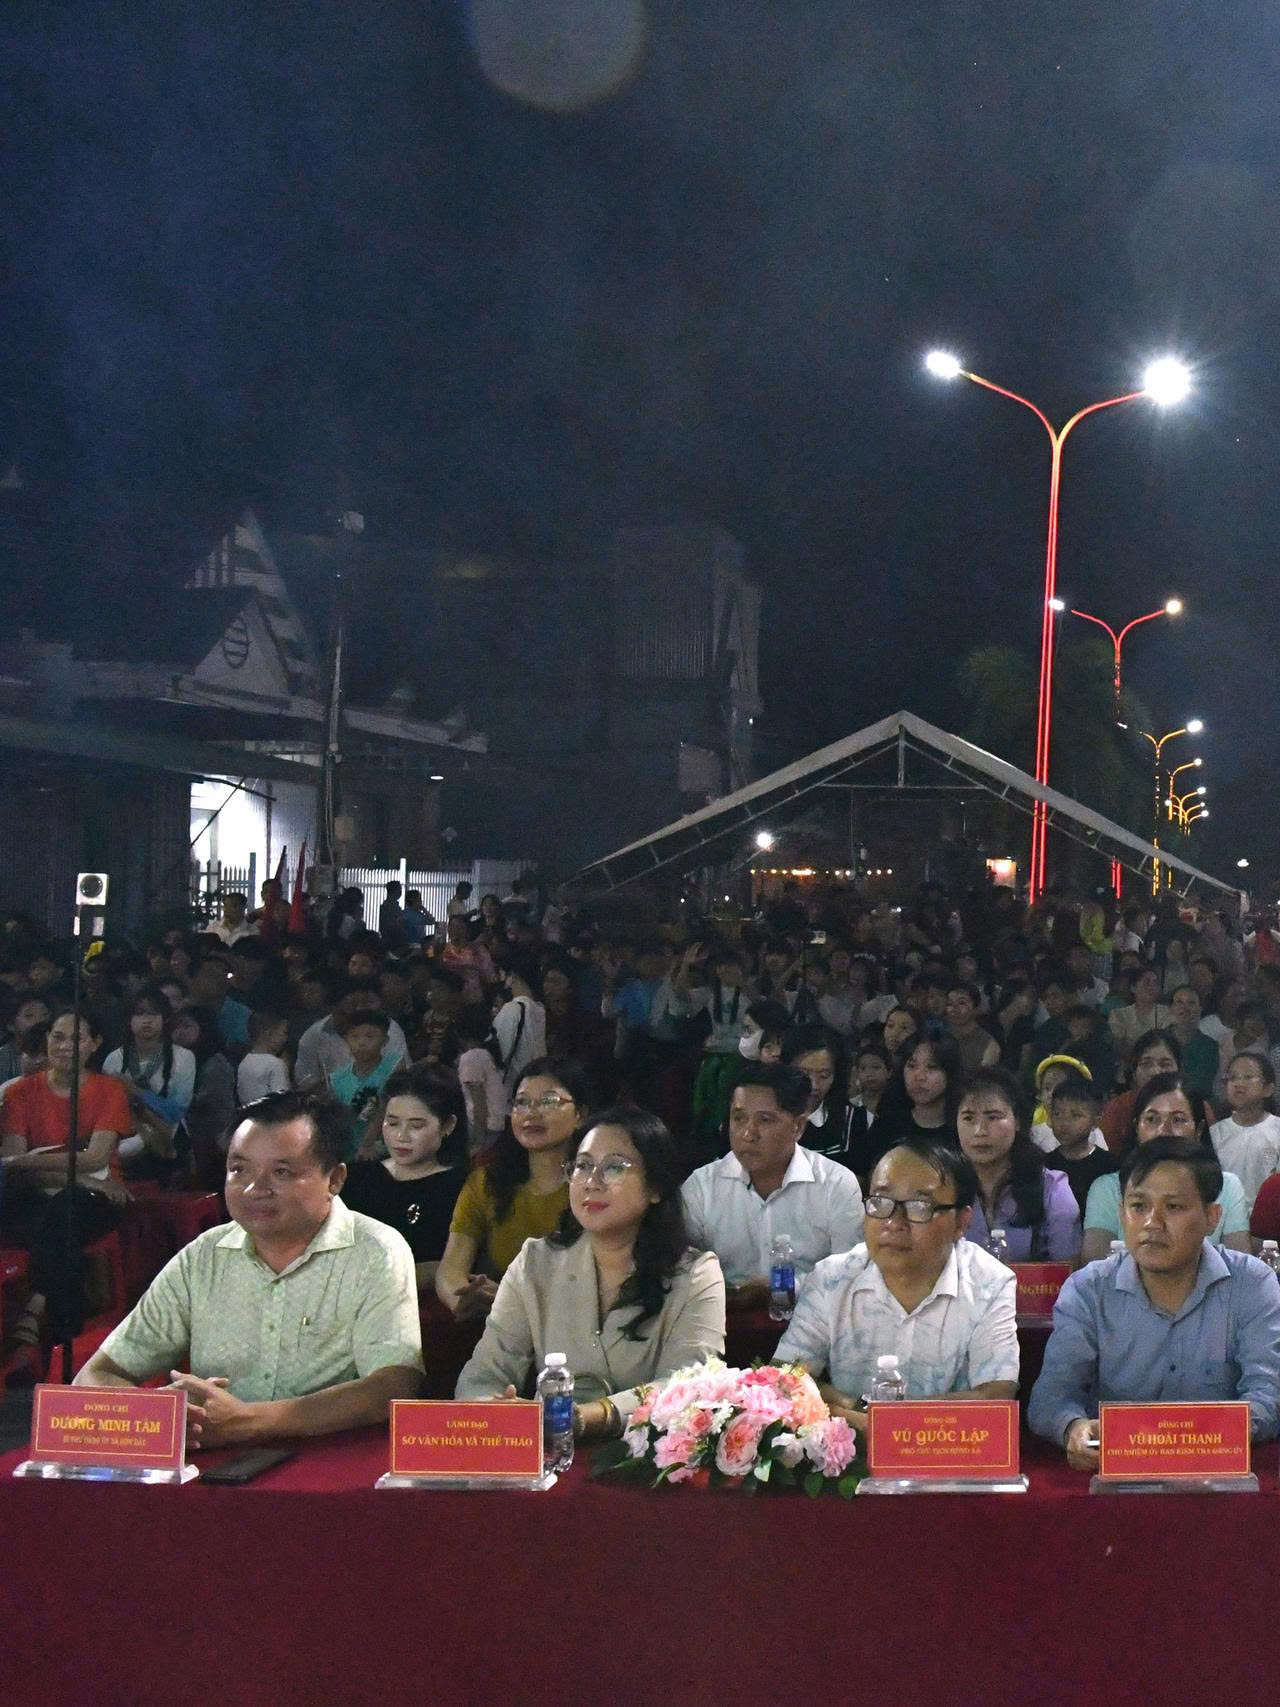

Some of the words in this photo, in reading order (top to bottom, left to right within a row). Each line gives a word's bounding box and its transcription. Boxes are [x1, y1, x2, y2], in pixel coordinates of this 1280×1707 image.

[50, 1415, 96, 1431] DƯƠNG
[98, 1419, 131, 1432] MINH
[134, 1418, 161, 1433] TÂM
[418, 1433, 440, 1446] VĂN
[892, 1427, 912, 1442] VŨ
[916, 1424, 957, 1446] QUỐC
[960, 1427, 989, 1445] LẬP
[1129, 1432, 1147, 1445] VŨ
[1148, 1431, 1178, 1445] HOÀI
[1180, 1432, 1223, 1445] THANH
